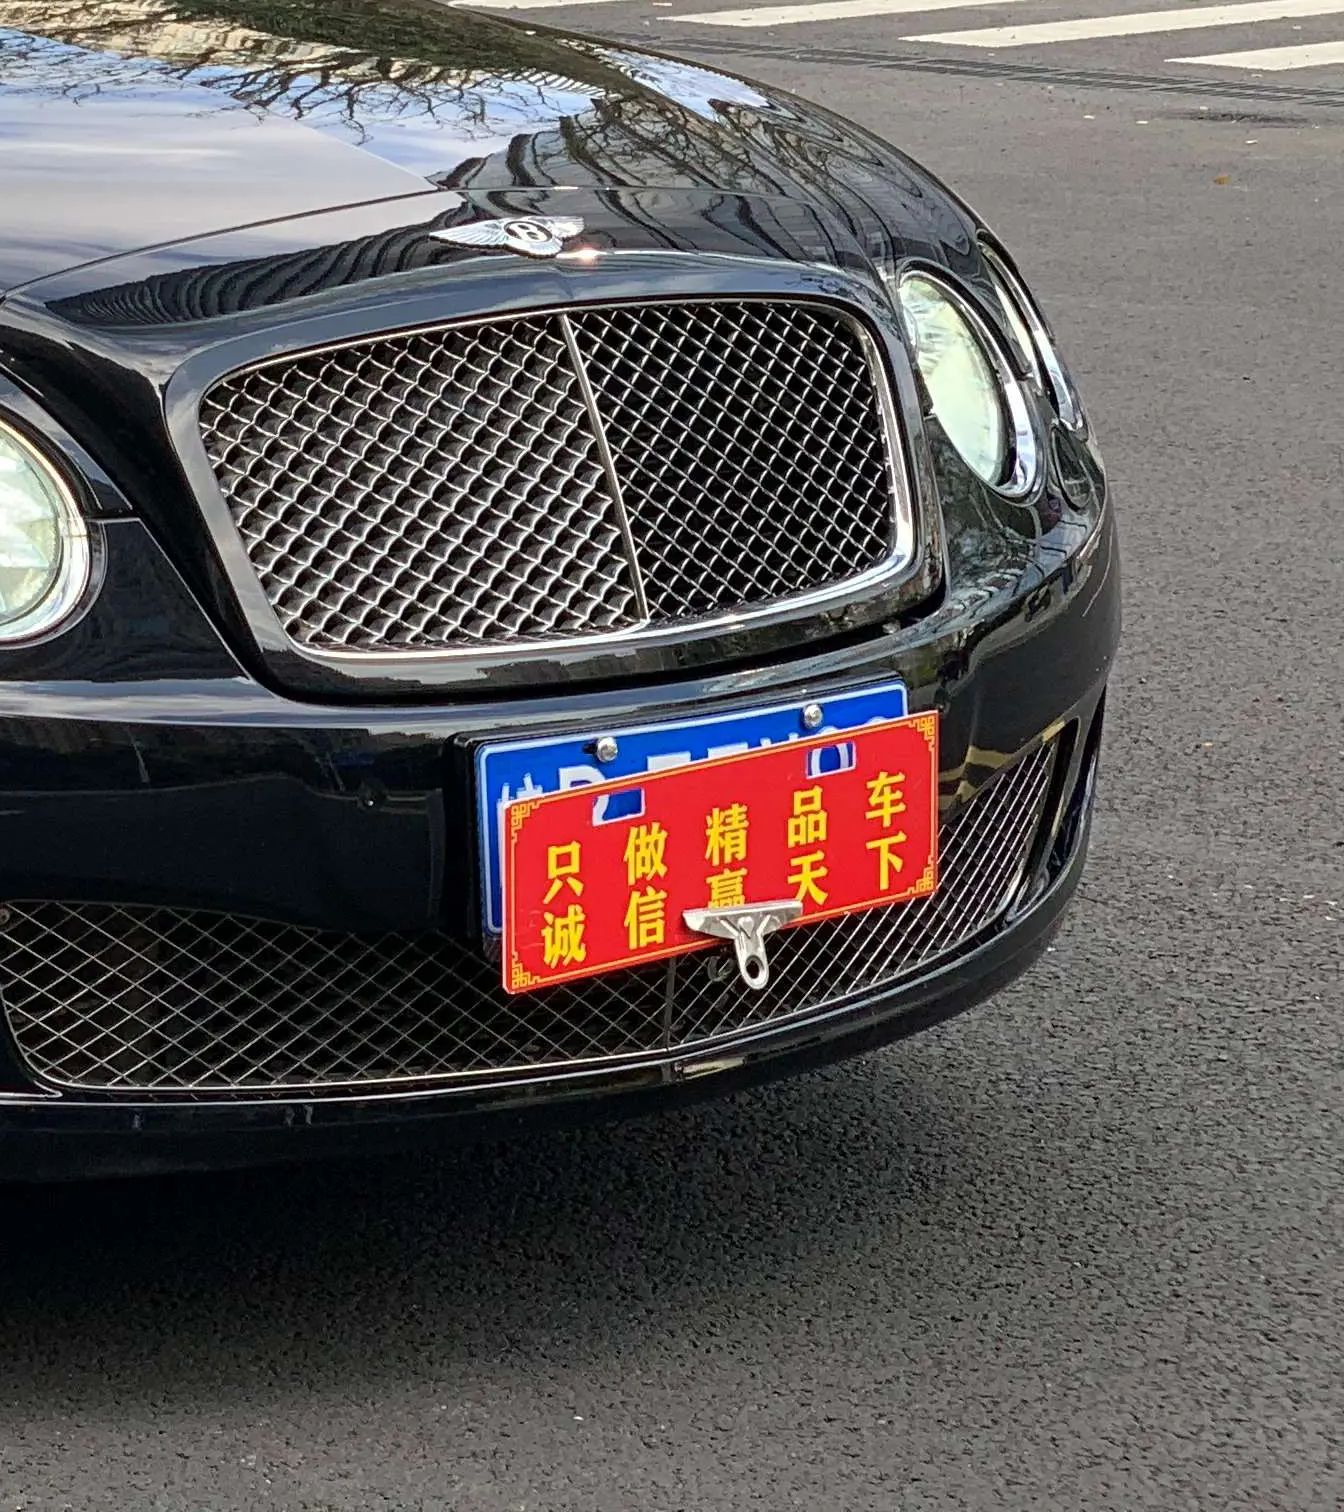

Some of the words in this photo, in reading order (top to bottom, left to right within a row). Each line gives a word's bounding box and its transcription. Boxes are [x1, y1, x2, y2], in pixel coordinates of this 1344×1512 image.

[543, 770, 907, 905] 只做精品车
